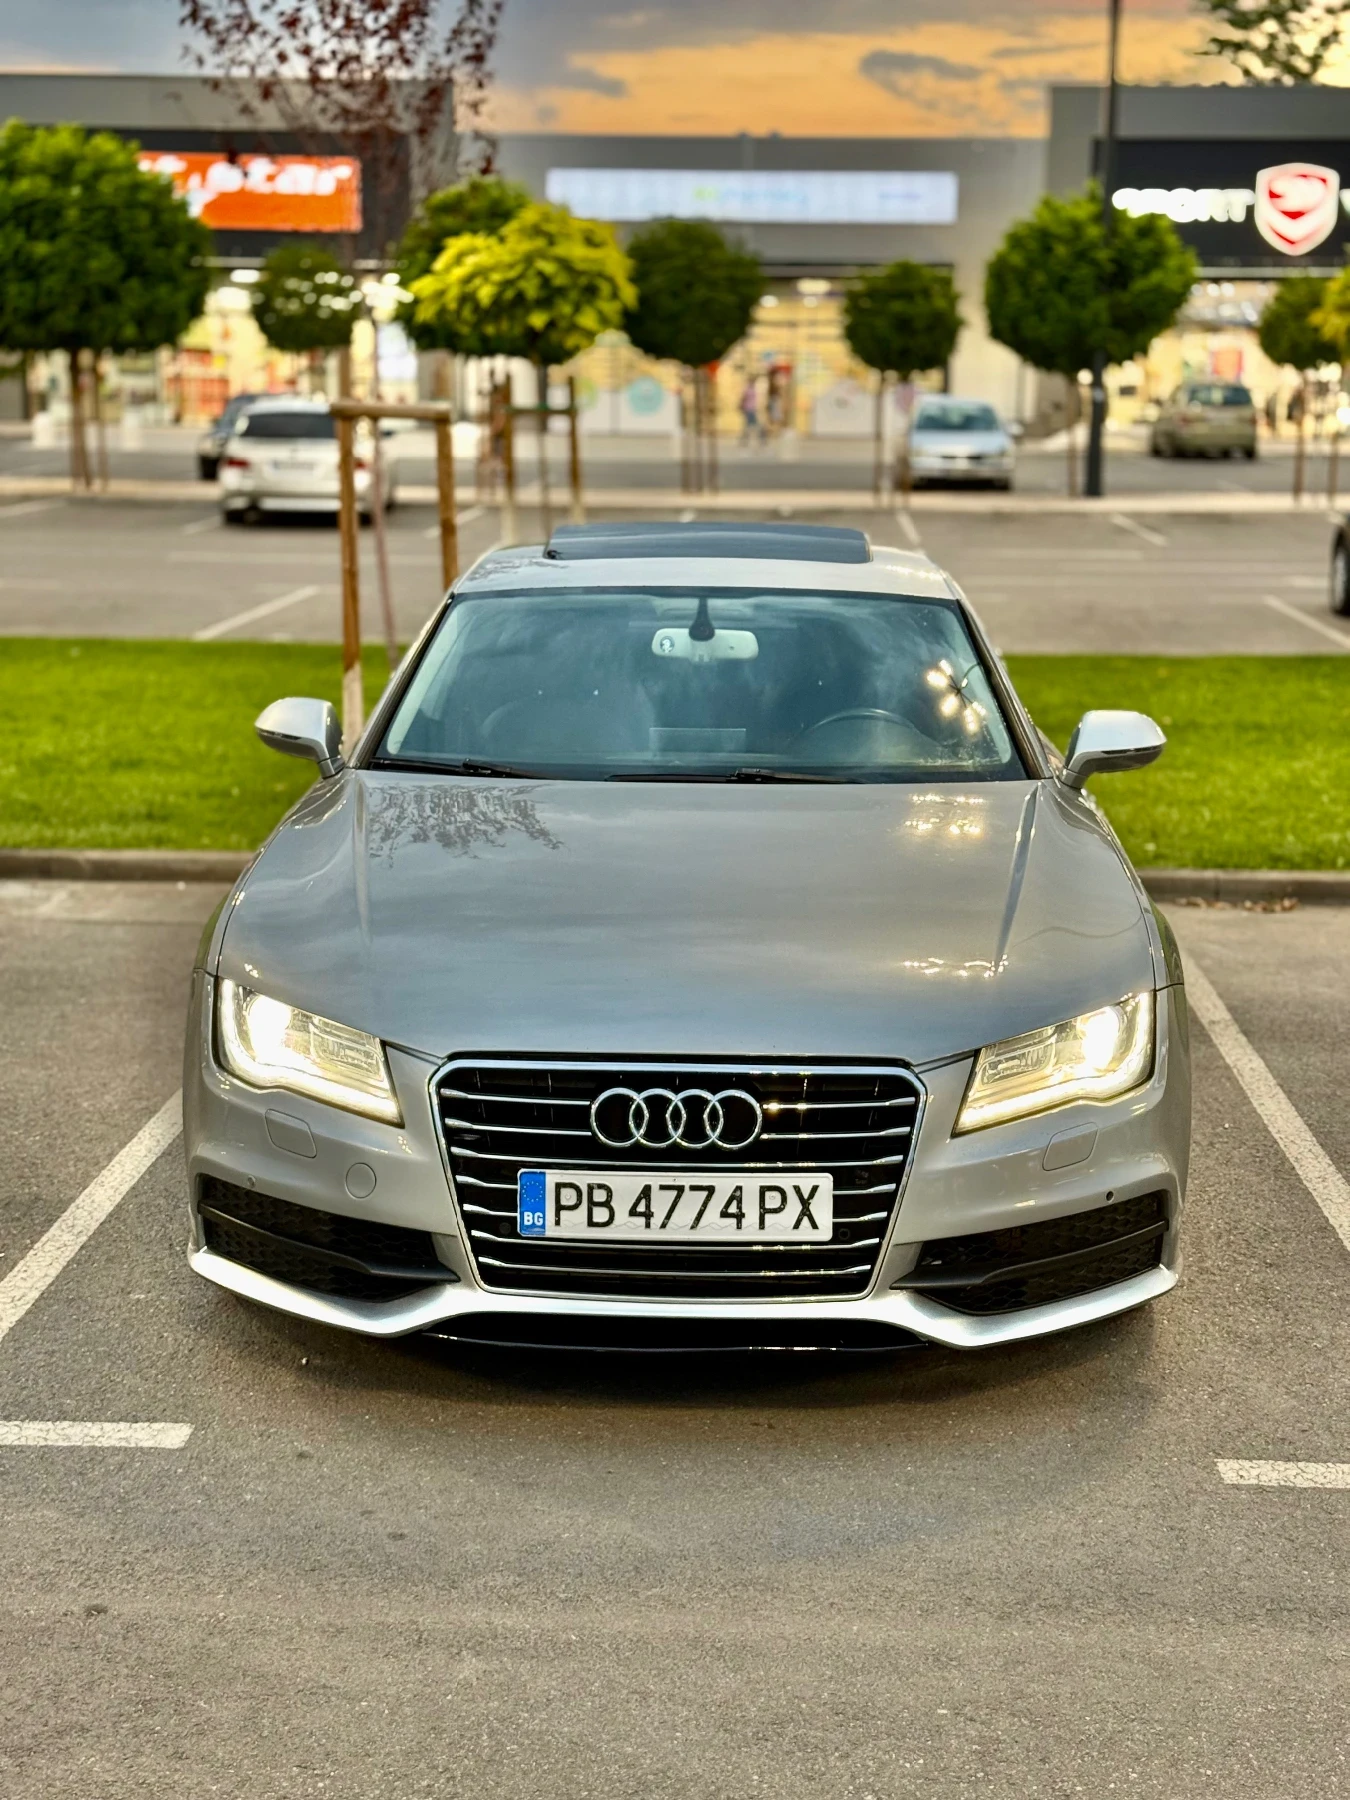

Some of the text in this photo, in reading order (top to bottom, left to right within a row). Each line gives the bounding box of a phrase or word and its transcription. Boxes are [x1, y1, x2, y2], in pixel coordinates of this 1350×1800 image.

[523, 1211, 544, 1226] BG
[554, 1182, 820, 1230] PB 4774 PX
